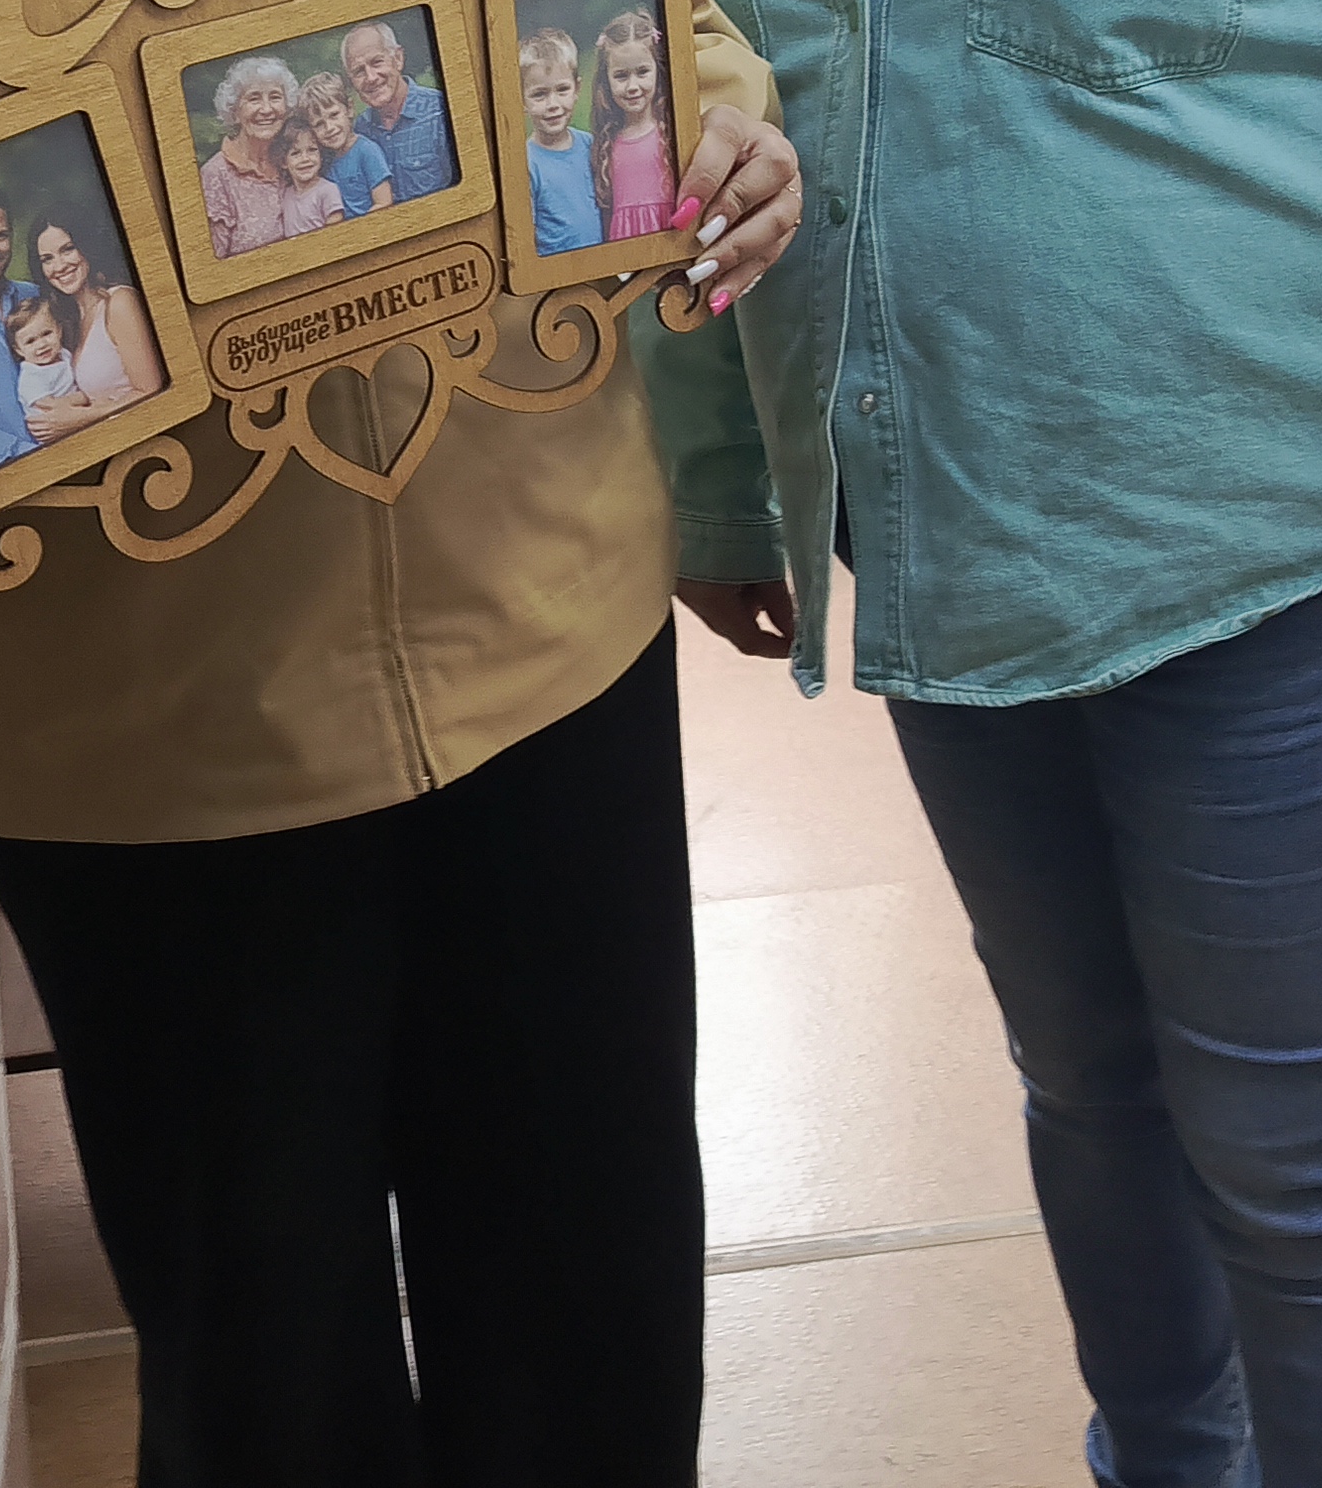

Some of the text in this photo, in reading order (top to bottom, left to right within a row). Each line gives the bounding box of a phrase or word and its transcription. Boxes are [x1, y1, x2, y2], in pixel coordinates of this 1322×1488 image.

[332, 259, 479, 336] ВМЕСТЕ!
[227, 308, 329, 356] Выбираем
[228, 322, 331, 374] будущее
